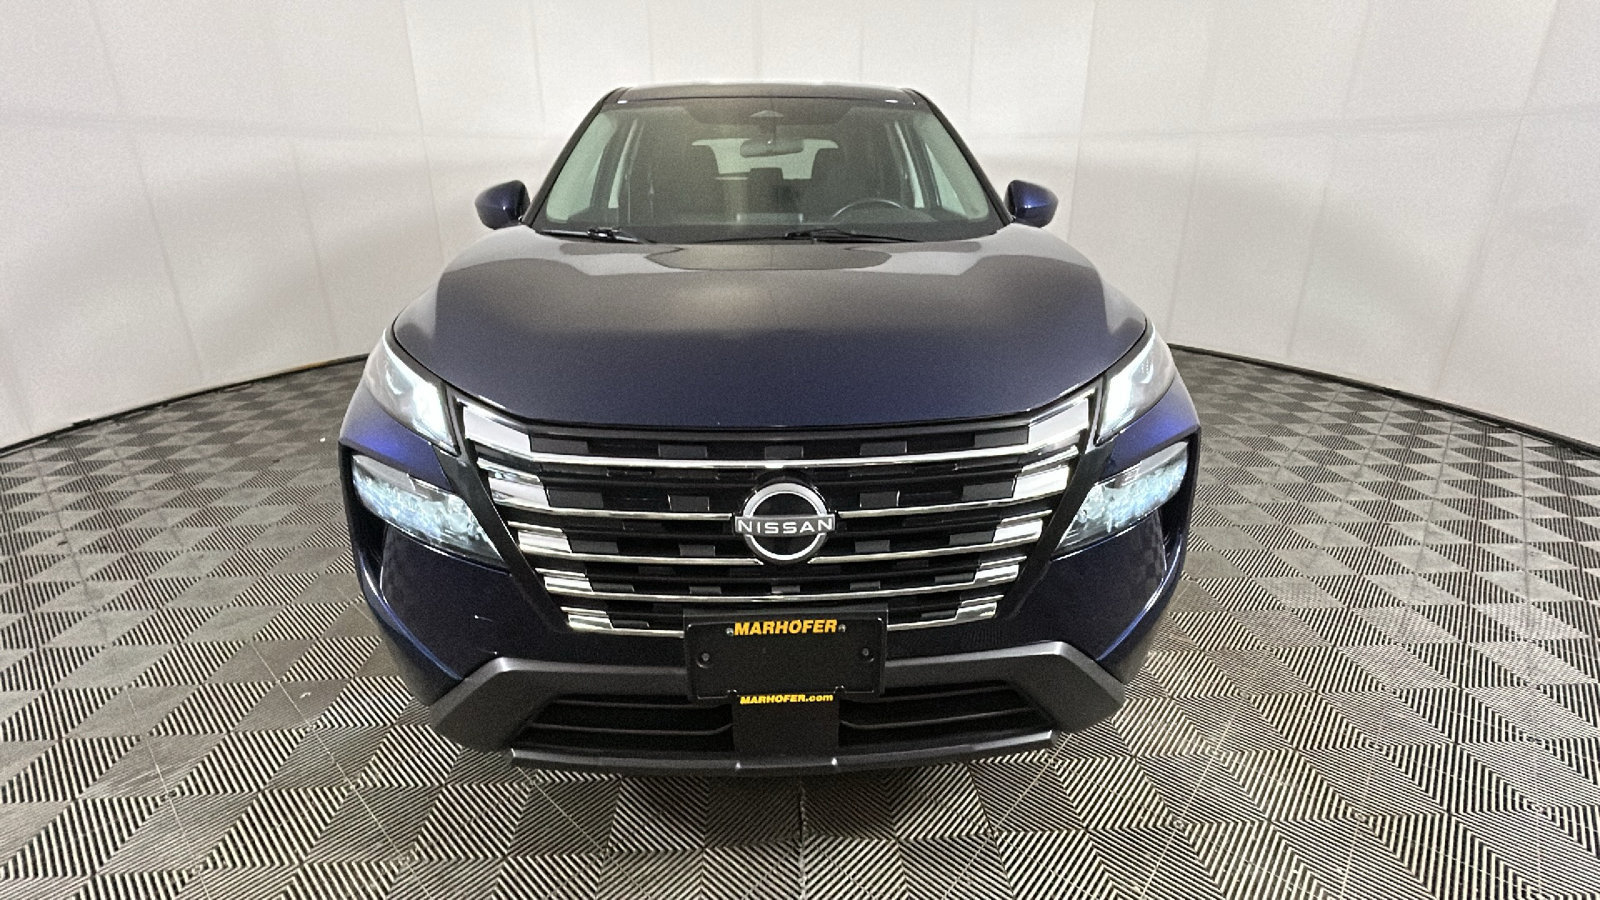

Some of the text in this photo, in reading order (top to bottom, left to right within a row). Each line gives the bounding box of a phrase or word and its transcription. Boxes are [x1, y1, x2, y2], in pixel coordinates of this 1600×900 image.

[738, 518, 833, 534] NISSAN
[734, 619, 838, 636] MARHOFER
[739, 694, 834, 705] MARHOFER.com
